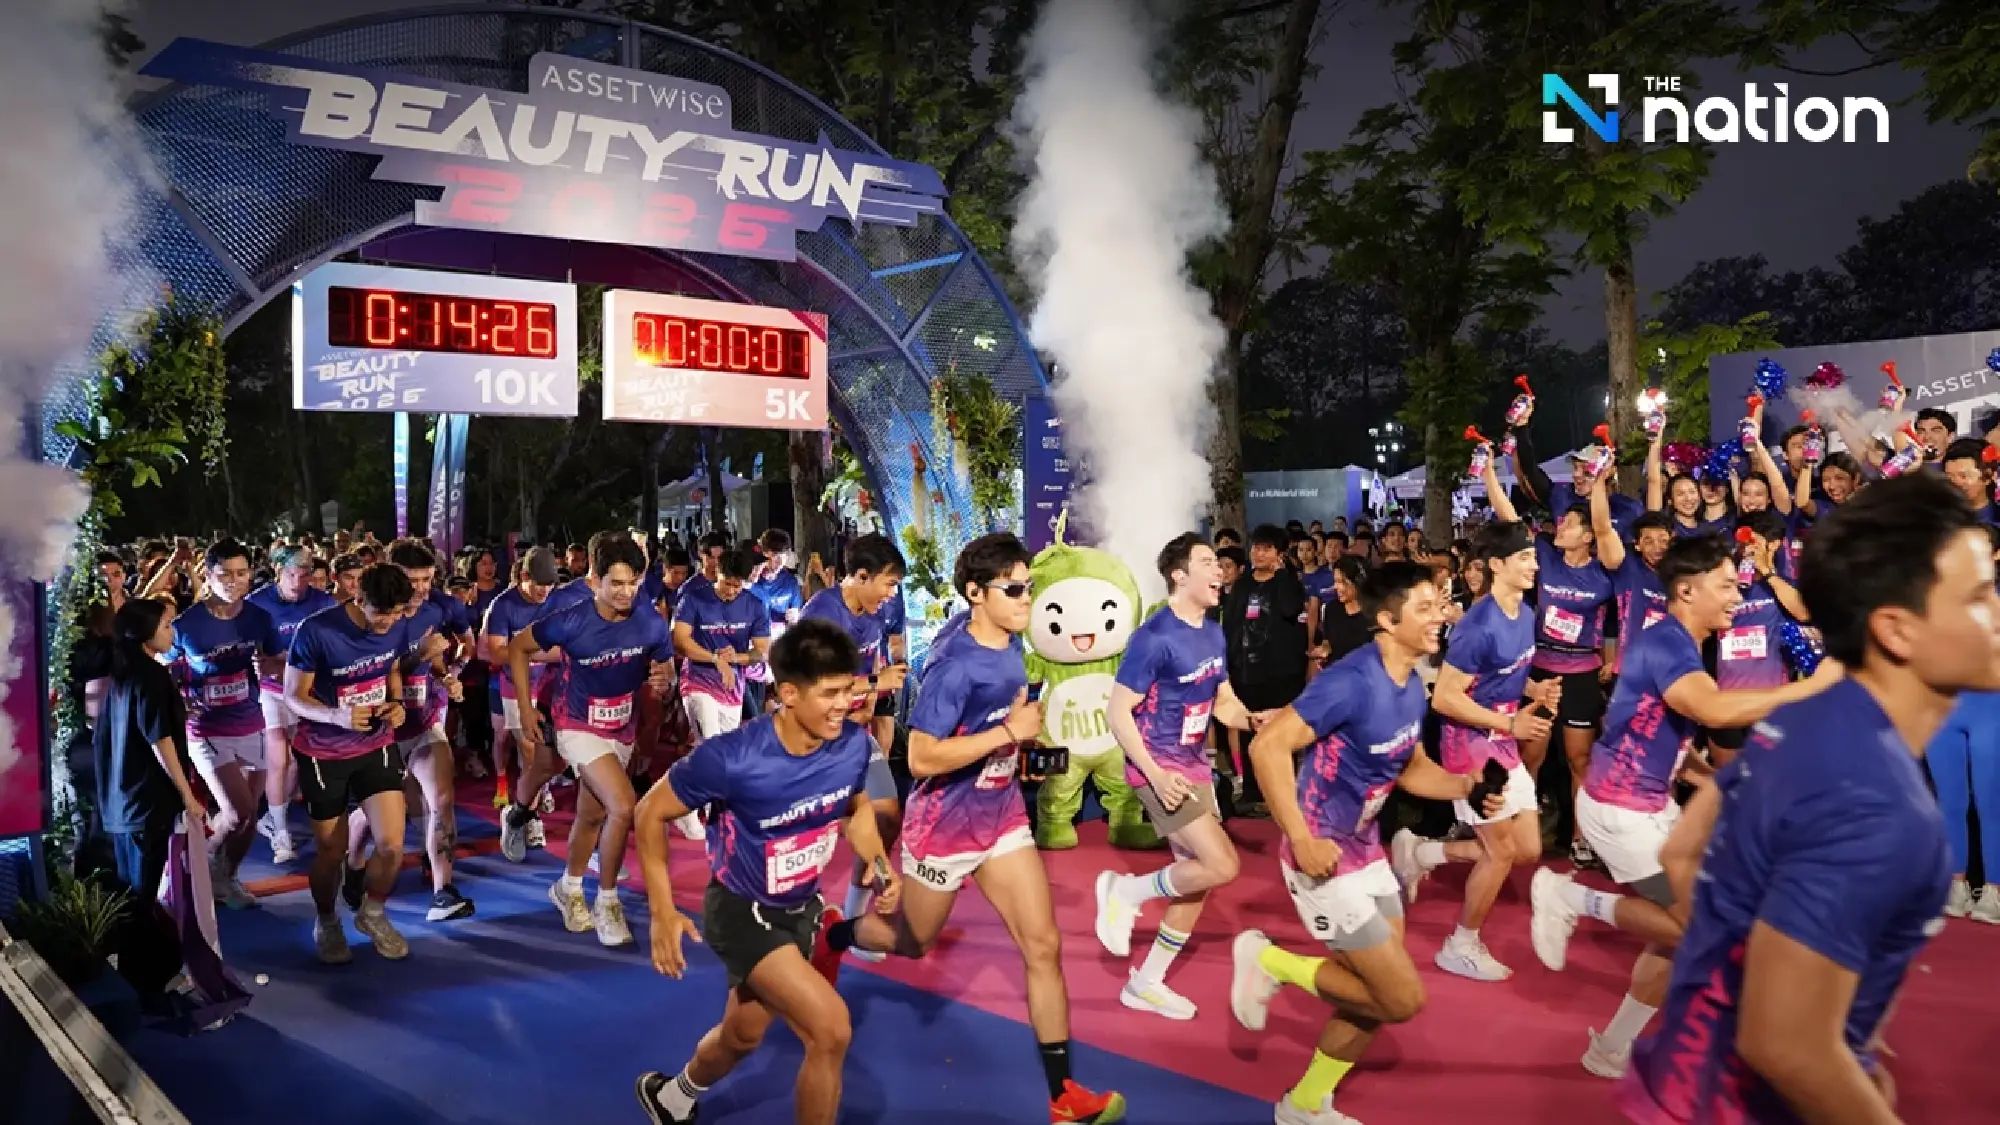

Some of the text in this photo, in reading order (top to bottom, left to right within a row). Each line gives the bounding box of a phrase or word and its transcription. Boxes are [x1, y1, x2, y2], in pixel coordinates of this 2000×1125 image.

[284, 66, 905, 222] BEAUTY RUN
[366, 292, 553, 355] 0:14:26
[315, 351, 421, 382] BEAUTY
[1916, 368, 1989, 400] ASSET
[340, 373, 404, 399] RUN
[474, 367, 559, 406] 10K
[765, 388, 812, 421] 5K
[758, 785, 851, 829] BEAUTY RUN
